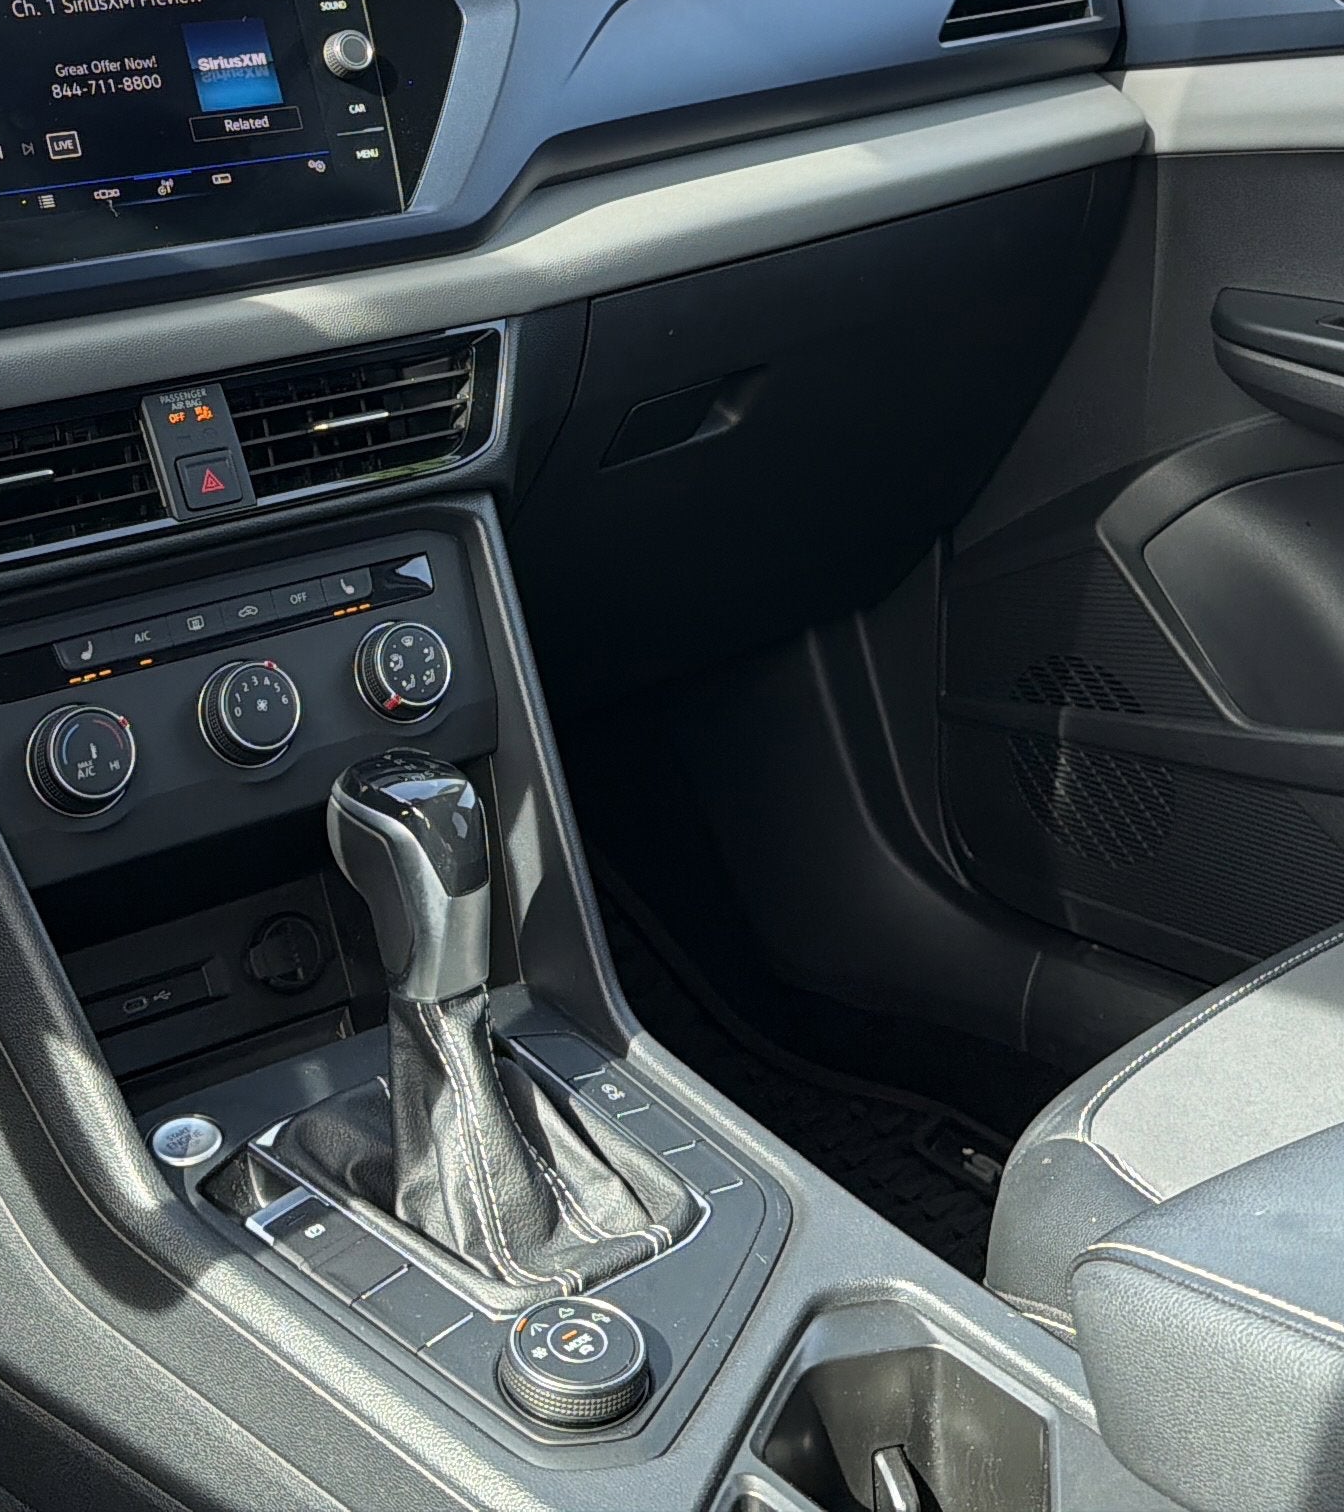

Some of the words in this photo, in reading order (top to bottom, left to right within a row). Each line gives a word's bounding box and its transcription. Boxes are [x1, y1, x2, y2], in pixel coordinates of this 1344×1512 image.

[12, 0, 42, 18] Ch.
[319, 0, 347, 12] SOUND
[55, 62, 89, 77] Great
[91, 59, 122, 73] Offer
[124, 55, 158, 70] Now!
[197, 51, 268, 72] SiriusXM
[51, 73, 162, 99] 844-711-8800
[348, 103, 366, 114] CAR
[223, 115, 270, 133] Related
[53, 141, 74, 151] LIVE
[356, 148, 379, 159] MENU
[159, 388, 208, 405] PASSENGER
[171, 401, 185, 411] AIR
[185, 398, 202, 409] BAG
[168, 411, 186, 424] OFF
[289, 591, 309, 605] OFF
[134, 630, 152, 644] A/C
[251, 675, 259, 686] 3
[242, 682, 250, 693] 2
[273, 682, 281, 693] 5
[235, 692, 242, 703] 1
[281, 694, 289, 705] 6
[234, 706, 242, 717] 0
[77, 765, 97, 780] A/C
